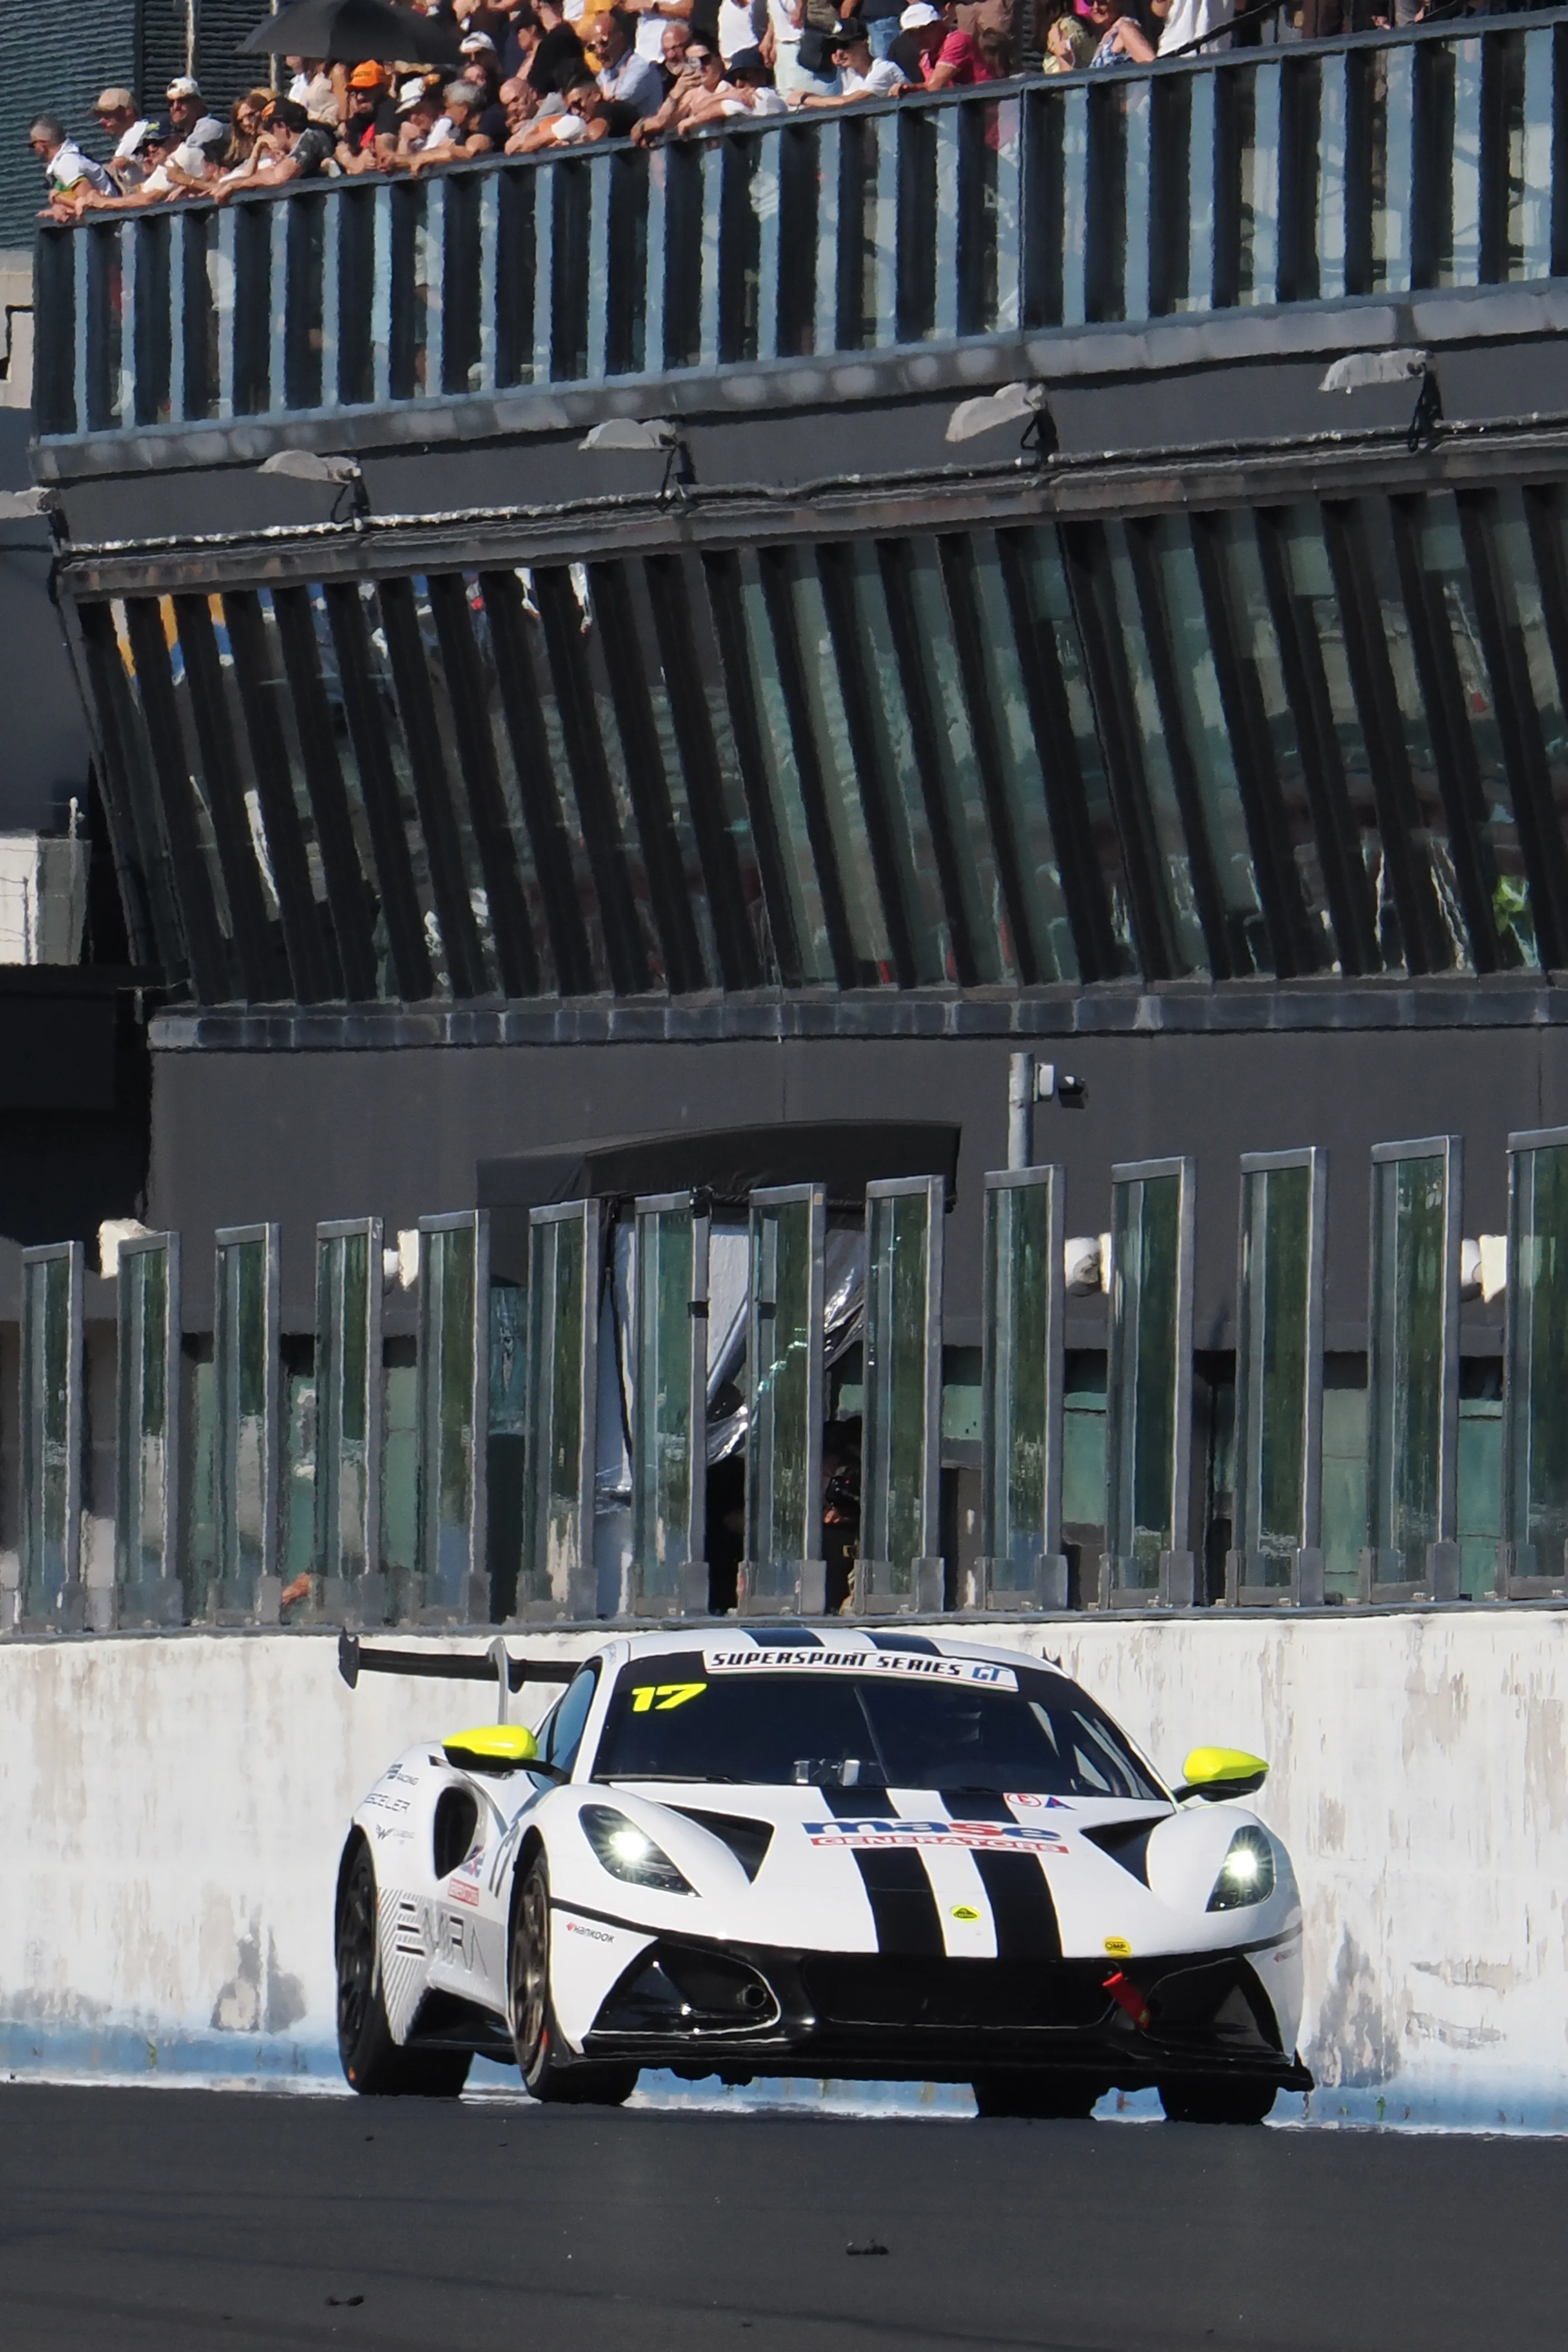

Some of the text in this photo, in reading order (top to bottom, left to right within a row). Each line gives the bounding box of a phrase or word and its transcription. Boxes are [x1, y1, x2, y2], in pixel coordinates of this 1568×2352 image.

[711, 1651, 1009, 1681] SUPERSPORT SERIES GT
[632, 1683, 707, 1712] 17
[801, 1820, 1062, 1842] mase
[817, 1836, 1062, 1853] GENERATORS
